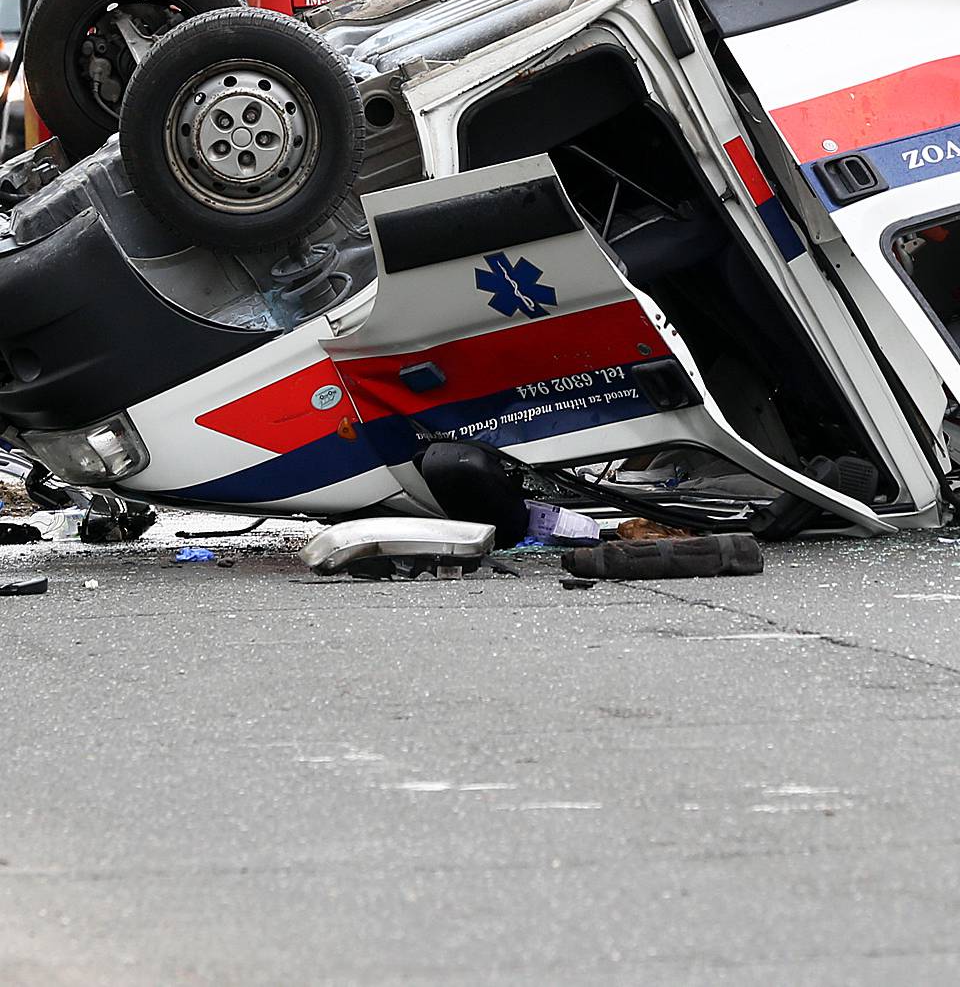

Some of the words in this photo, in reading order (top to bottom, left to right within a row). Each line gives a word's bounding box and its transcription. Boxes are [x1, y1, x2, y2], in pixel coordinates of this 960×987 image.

[551, 373, 594, 393] 6302
[594, 366, 626, 384] tel.
[516, 381, 550, 399] 944
[603, 387, 639, 404] Zavod
[554, 398, 587, 413] hitnu
[588, 395, 602, 404] za
[500, 403, 553, 424] medicinu
[459, 417, 499, 438] Grada
